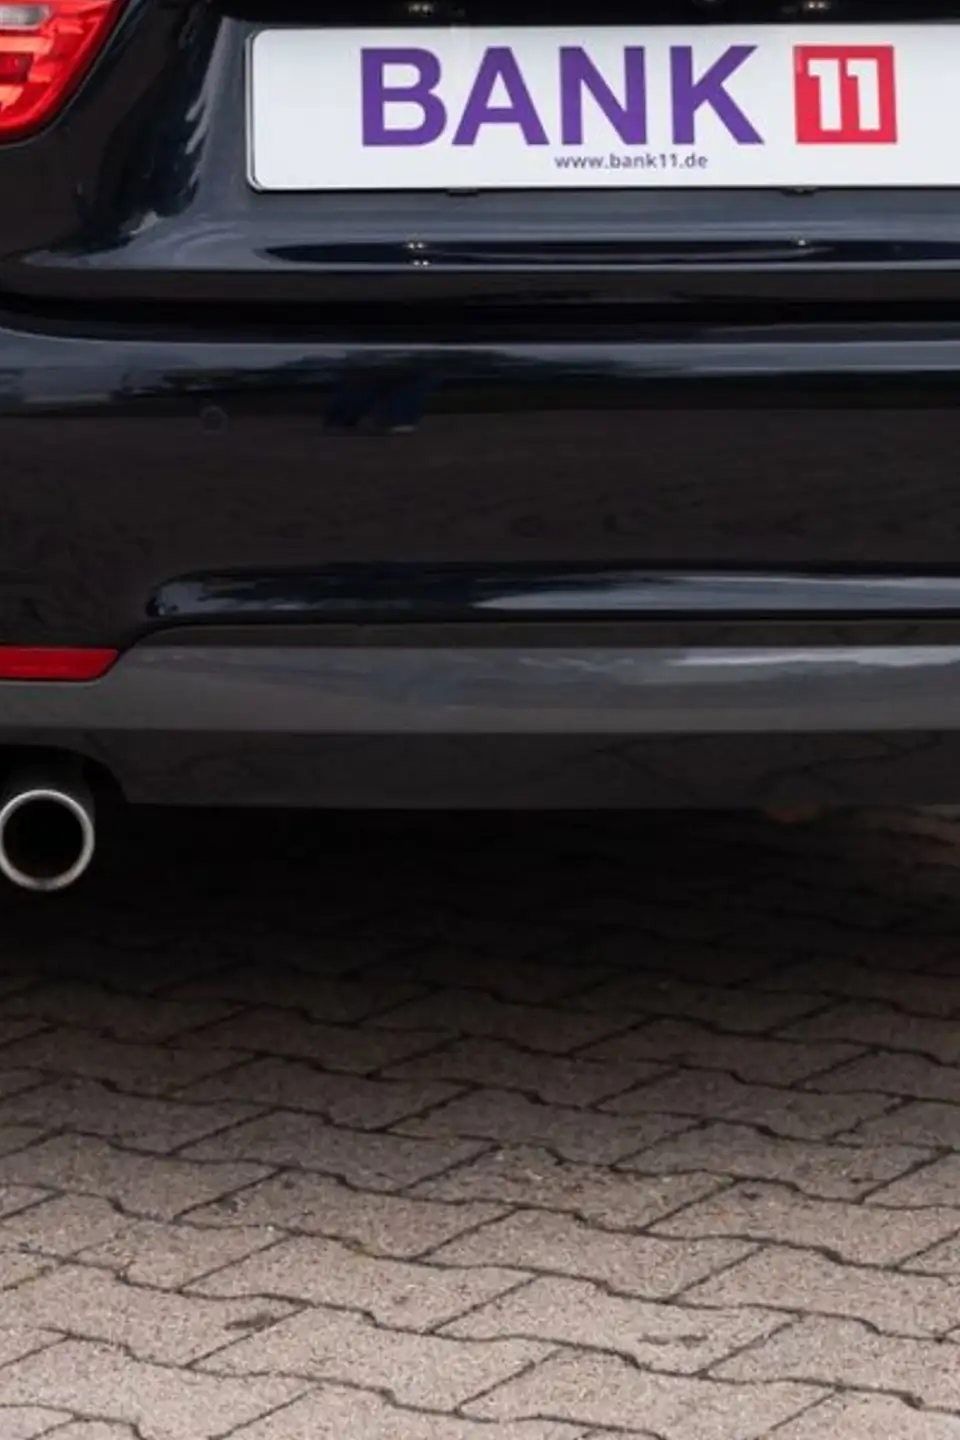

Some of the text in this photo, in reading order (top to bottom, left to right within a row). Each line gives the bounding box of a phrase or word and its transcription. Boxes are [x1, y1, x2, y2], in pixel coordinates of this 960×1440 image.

[360, 46, 883, 147] BANK 11
[554, 152, 709, 169] www.bank11.de
